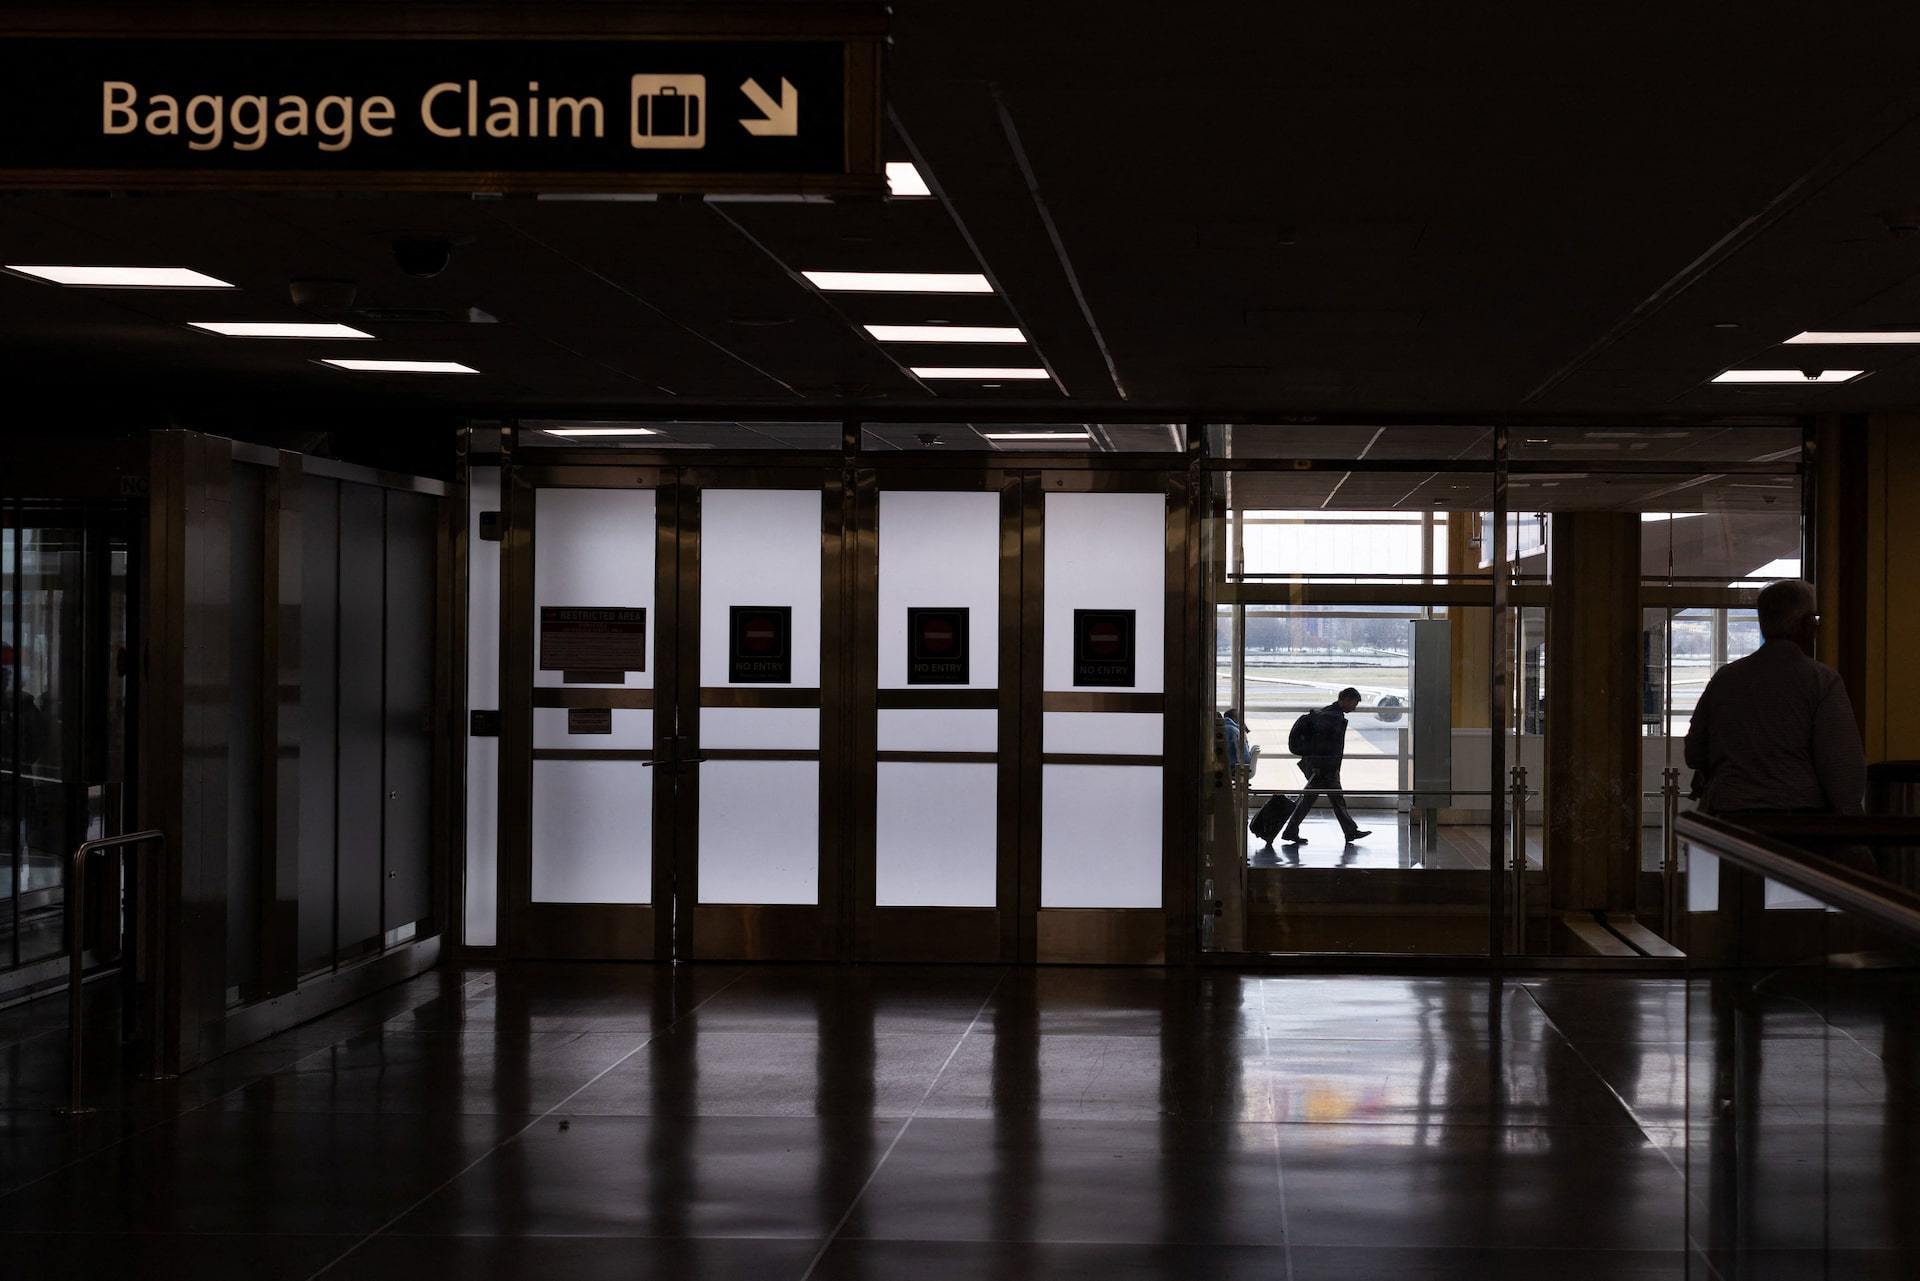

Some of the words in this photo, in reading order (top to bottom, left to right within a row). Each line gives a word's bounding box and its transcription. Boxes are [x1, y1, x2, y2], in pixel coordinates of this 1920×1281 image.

[103, 81, 395, 150] Baggage
[421, 80, 604, 136] Claim
[560, 610, 615, 621] RESTRICTED
[617, 611, 641, 621] AREA
[735, 662, 752, 672] NO
[753, 662, 785, 672] ENTRY
[914, 663, 929, 673] NO
[931, 663, 962, 673] ENTRY
[1079, 665, 1095, 675] NO
[1097, 665, 1129, 675] ENTRY
